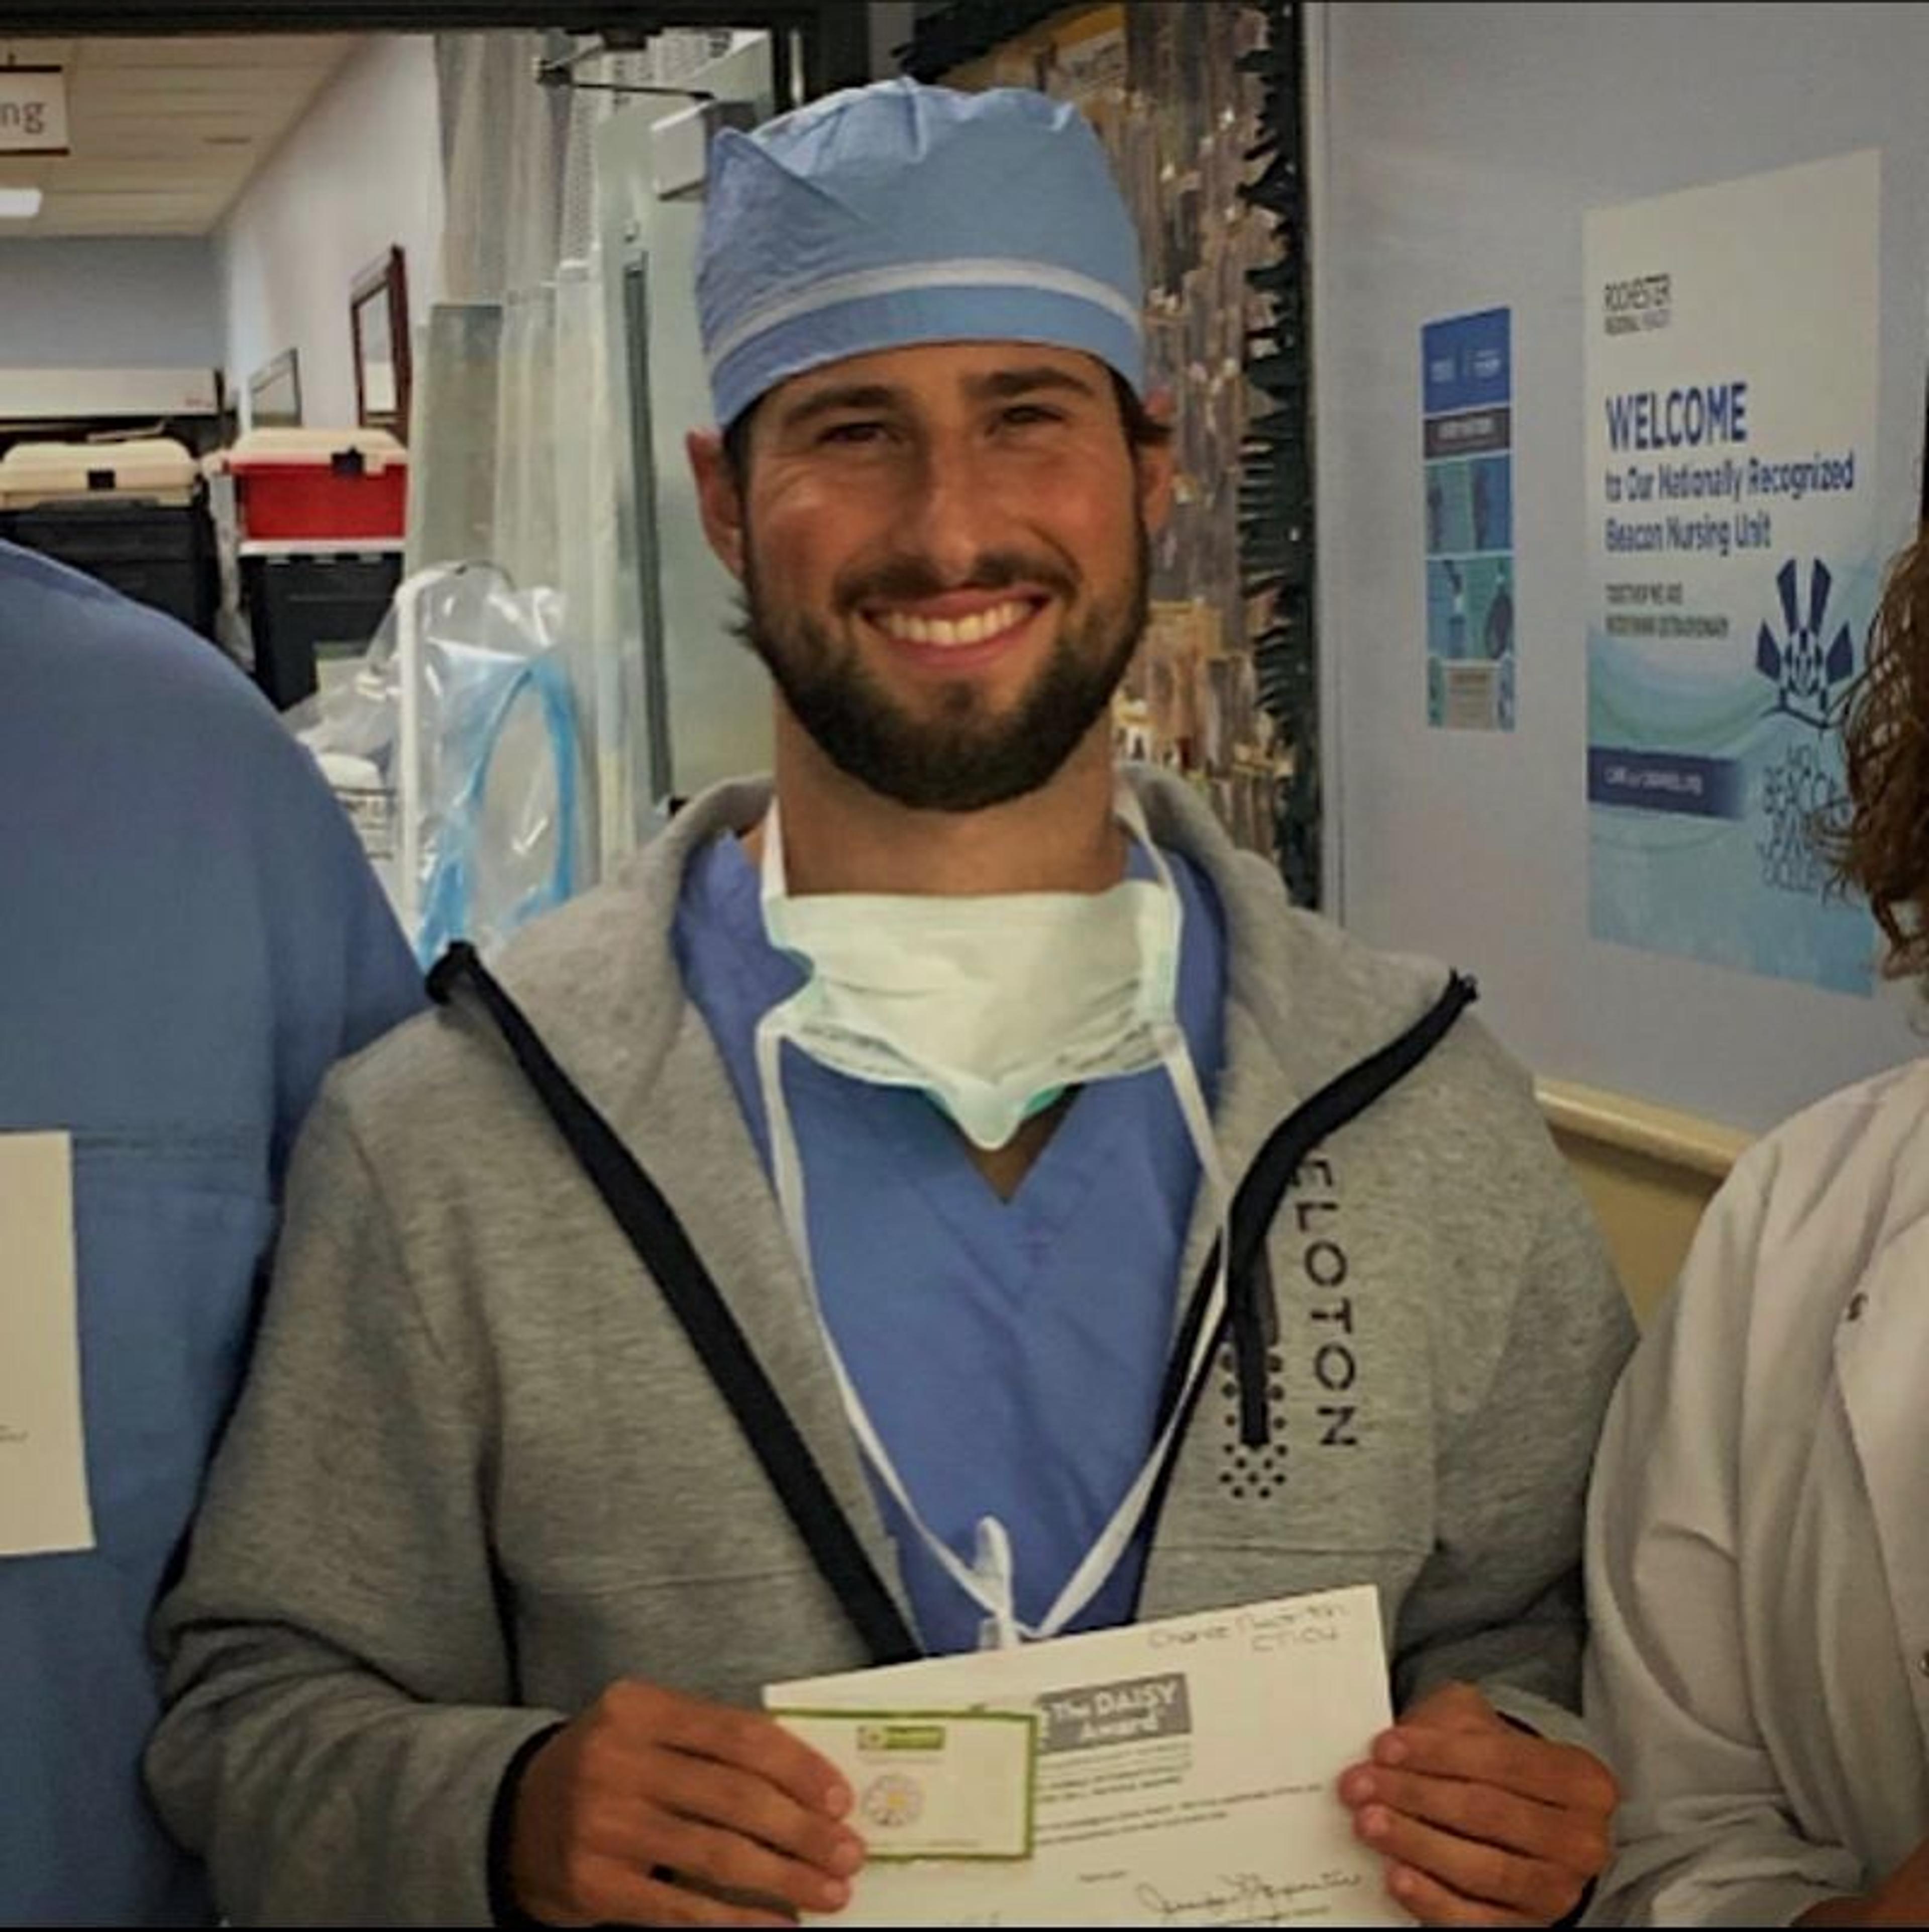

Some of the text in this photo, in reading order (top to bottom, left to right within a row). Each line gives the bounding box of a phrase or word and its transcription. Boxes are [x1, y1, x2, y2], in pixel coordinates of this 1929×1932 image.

[1605, 381, 1747, 450] WELCOME
[1606, 451, 1854, 503] to Our Nationally Recognized
[1606, 509, 1771, 557] Beacon Nursing Unit
[1051, 1681, 1177, 1722] The DAISY
[1080, 1702, 1158, 1739] Award
